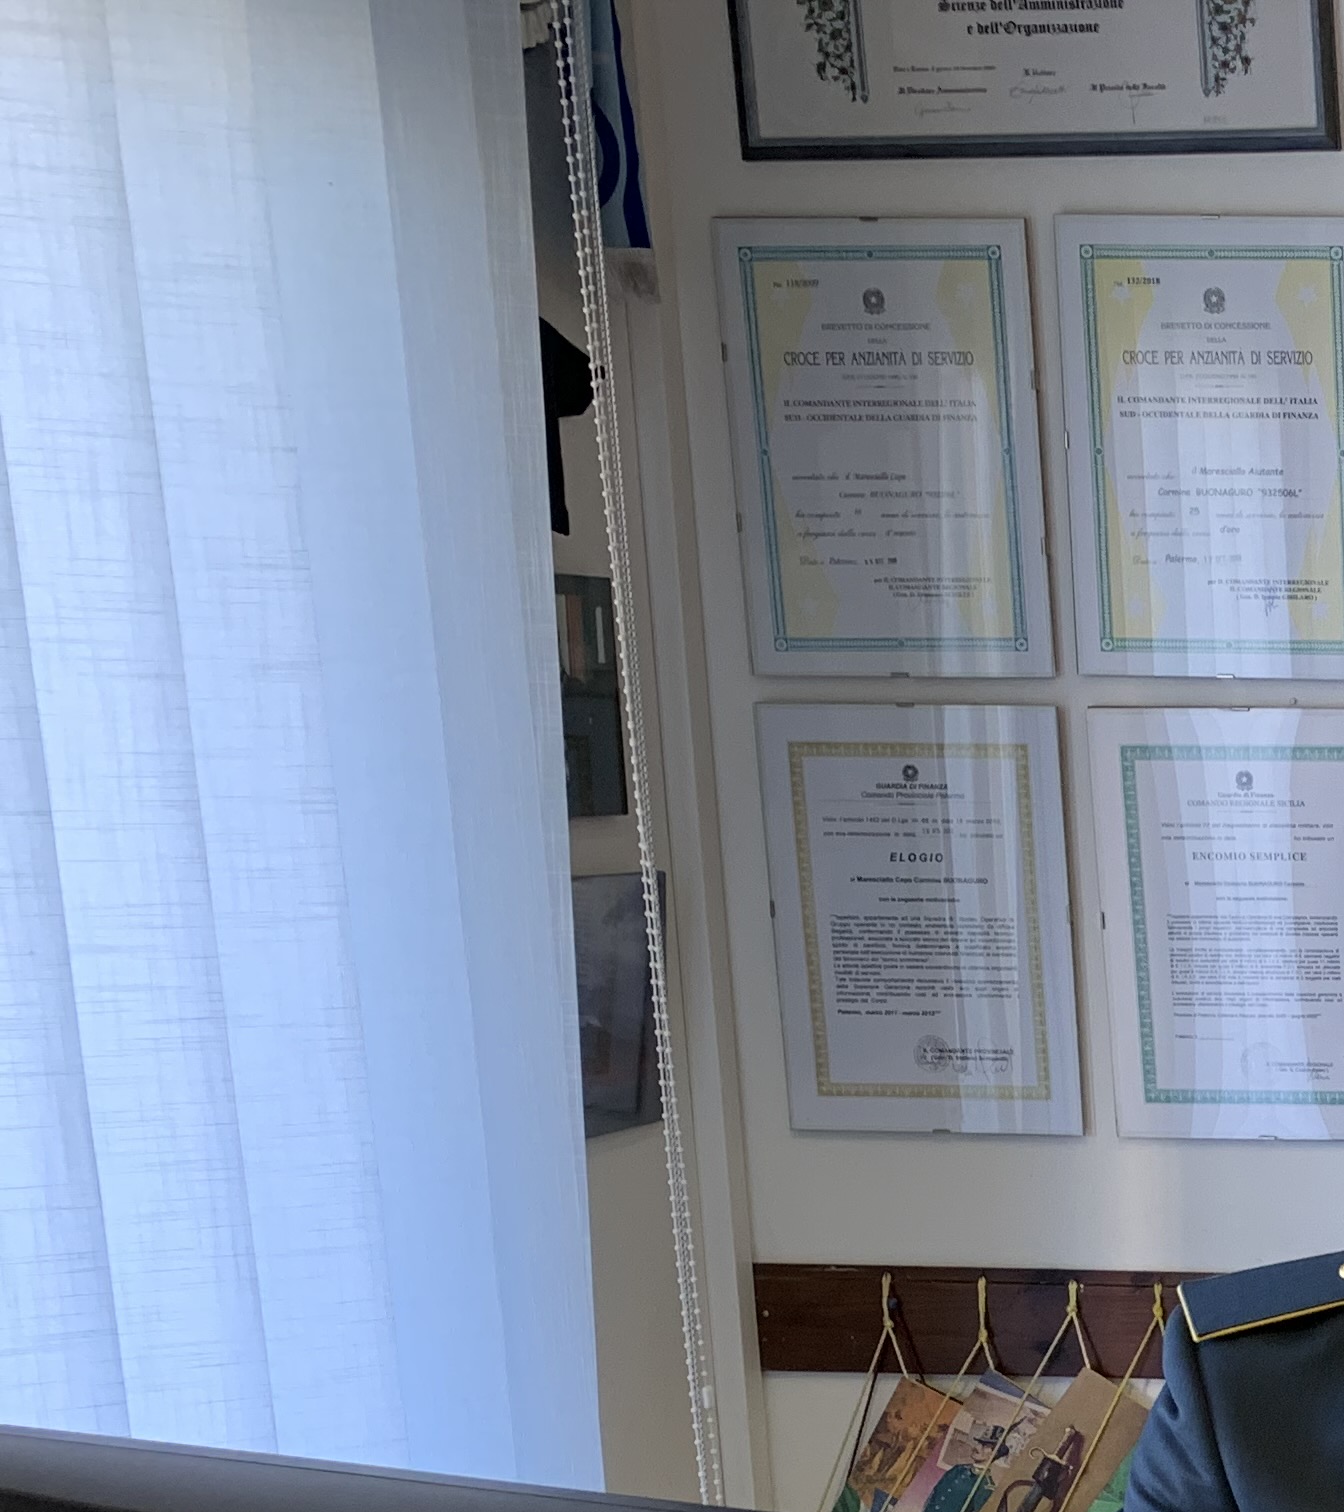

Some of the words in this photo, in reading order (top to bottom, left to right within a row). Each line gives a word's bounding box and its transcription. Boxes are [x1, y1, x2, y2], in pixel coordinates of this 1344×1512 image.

[1127, 277, 1161, 285] 132/2018
[1161, 322, 1202, 330] BREVETTO
[1204, 322, 1213, 330] DI
[1214, 322, 1270, 330] CONCESSIONE
[784, 352, 821, 366] CROCE
[826, 352, 846, 366] PER
[851, 348, 907, 366] ANZIANITÀ
[912, 352, 922, 365] DI
[927, 352, 974, 366] SERVIZIO
[1123, 351, 1159, 365] CROCE
[1165, 351, 1184, 365] PER
[1190, 347, 1245, 365] ANZIANITÀ
[1251, 351, 1261, 365] DI
[1267, 351, 1313, 365] SERVIZIO
[1128, 397, 1186, 405] COMANDANTE
[1290, 397, 1318, 405] ITALIA
[1283, 412, 1319, 420] FINANZA
[1249, 468, 1284, 476] Aiutante
[1158, 488, 1190, 496] Carmine
[1196, 488, 1253, 497] BUONAGURO
[890, 852, 943, 862] ELOGIO
[1192, 852, 1246, 861] ENCOMIO
[1250, 852, 1307, 861] SEMPLICE
